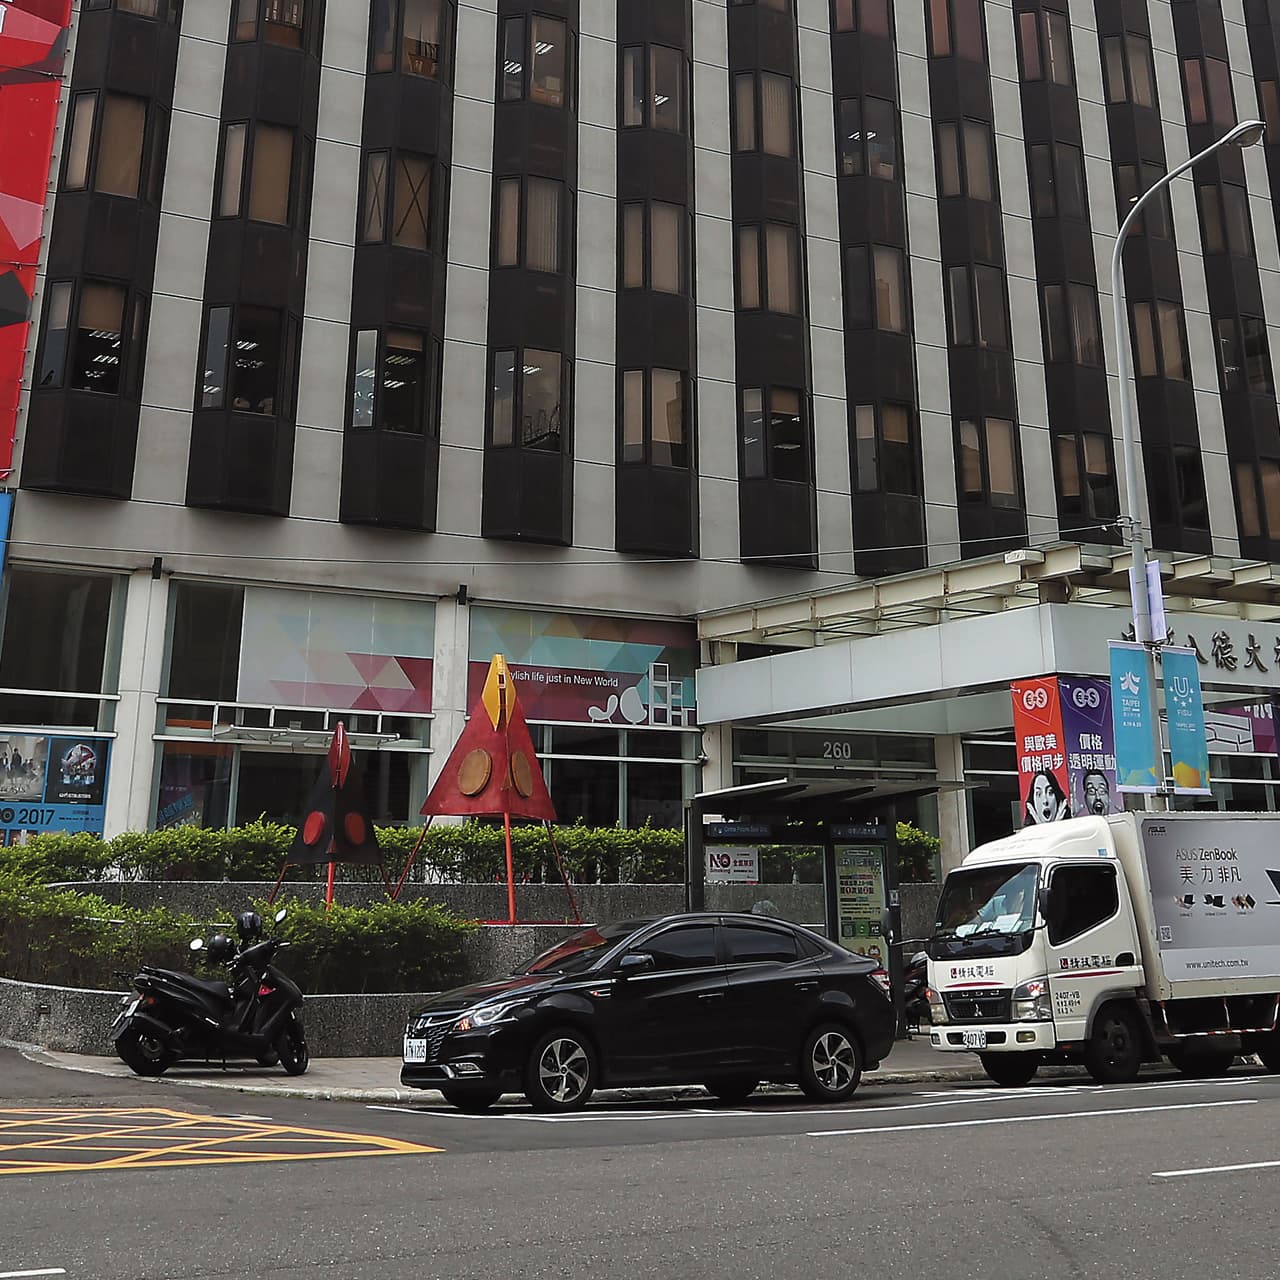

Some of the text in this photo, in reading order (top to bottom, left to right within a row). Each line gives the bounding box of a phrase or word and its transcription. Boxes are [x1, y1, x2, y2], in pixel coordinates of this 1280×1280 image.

[531, 671, 545, 683] life
[545, 672, 562, 685] just
[563, 674, 572, 684] in
[573, 675, 593, 686] New
[594, 676, 619, 688] World
[823, 741, 851, 759] 260
[1023, 733, 1057, 753] 與歐美
[1079, 733, 1103, 751] 價格
[1021, 752, 1064, 773] 價格同步
[1069, 752, 1117, 771] 透明運動
[17, 808, 56, 826] 2017
[1175, 847, 1238, 861] ASUS ZenBook
[1186, 959, 1249, 969] www.unitech.com.tw
